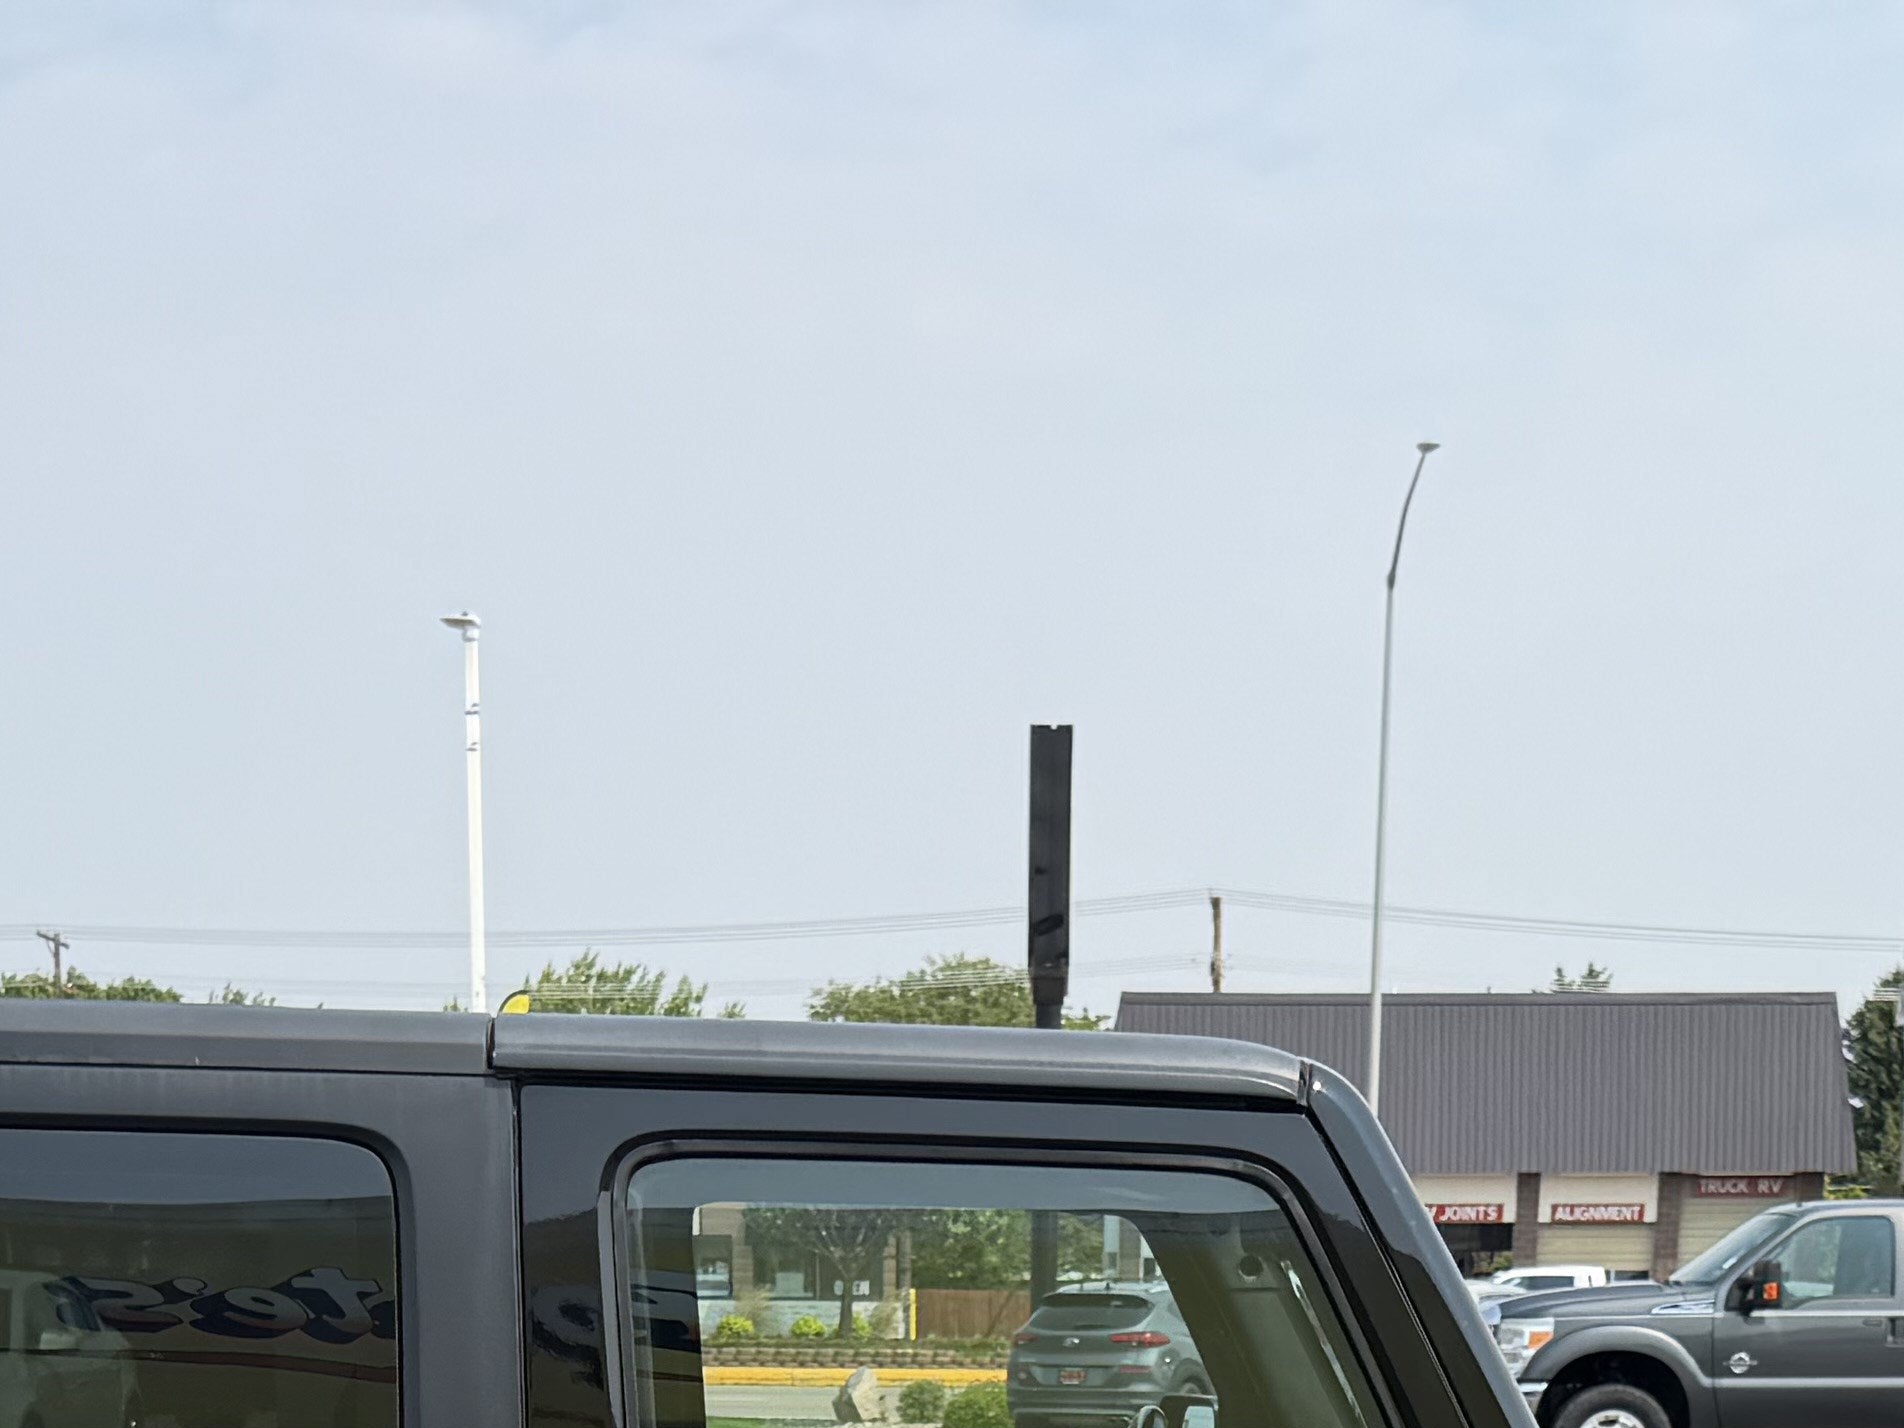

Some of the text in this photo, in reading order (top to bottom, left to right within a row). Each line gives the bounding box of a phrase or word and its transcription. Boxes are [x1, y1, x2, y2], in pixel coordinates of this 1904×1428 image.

[1700, 1178, 1785, 1194] TRUCK RV
[1440, 1205, 1498, 1222] JOINTS
[1554, 1205, 1641, 1222] ALIGNMENT
